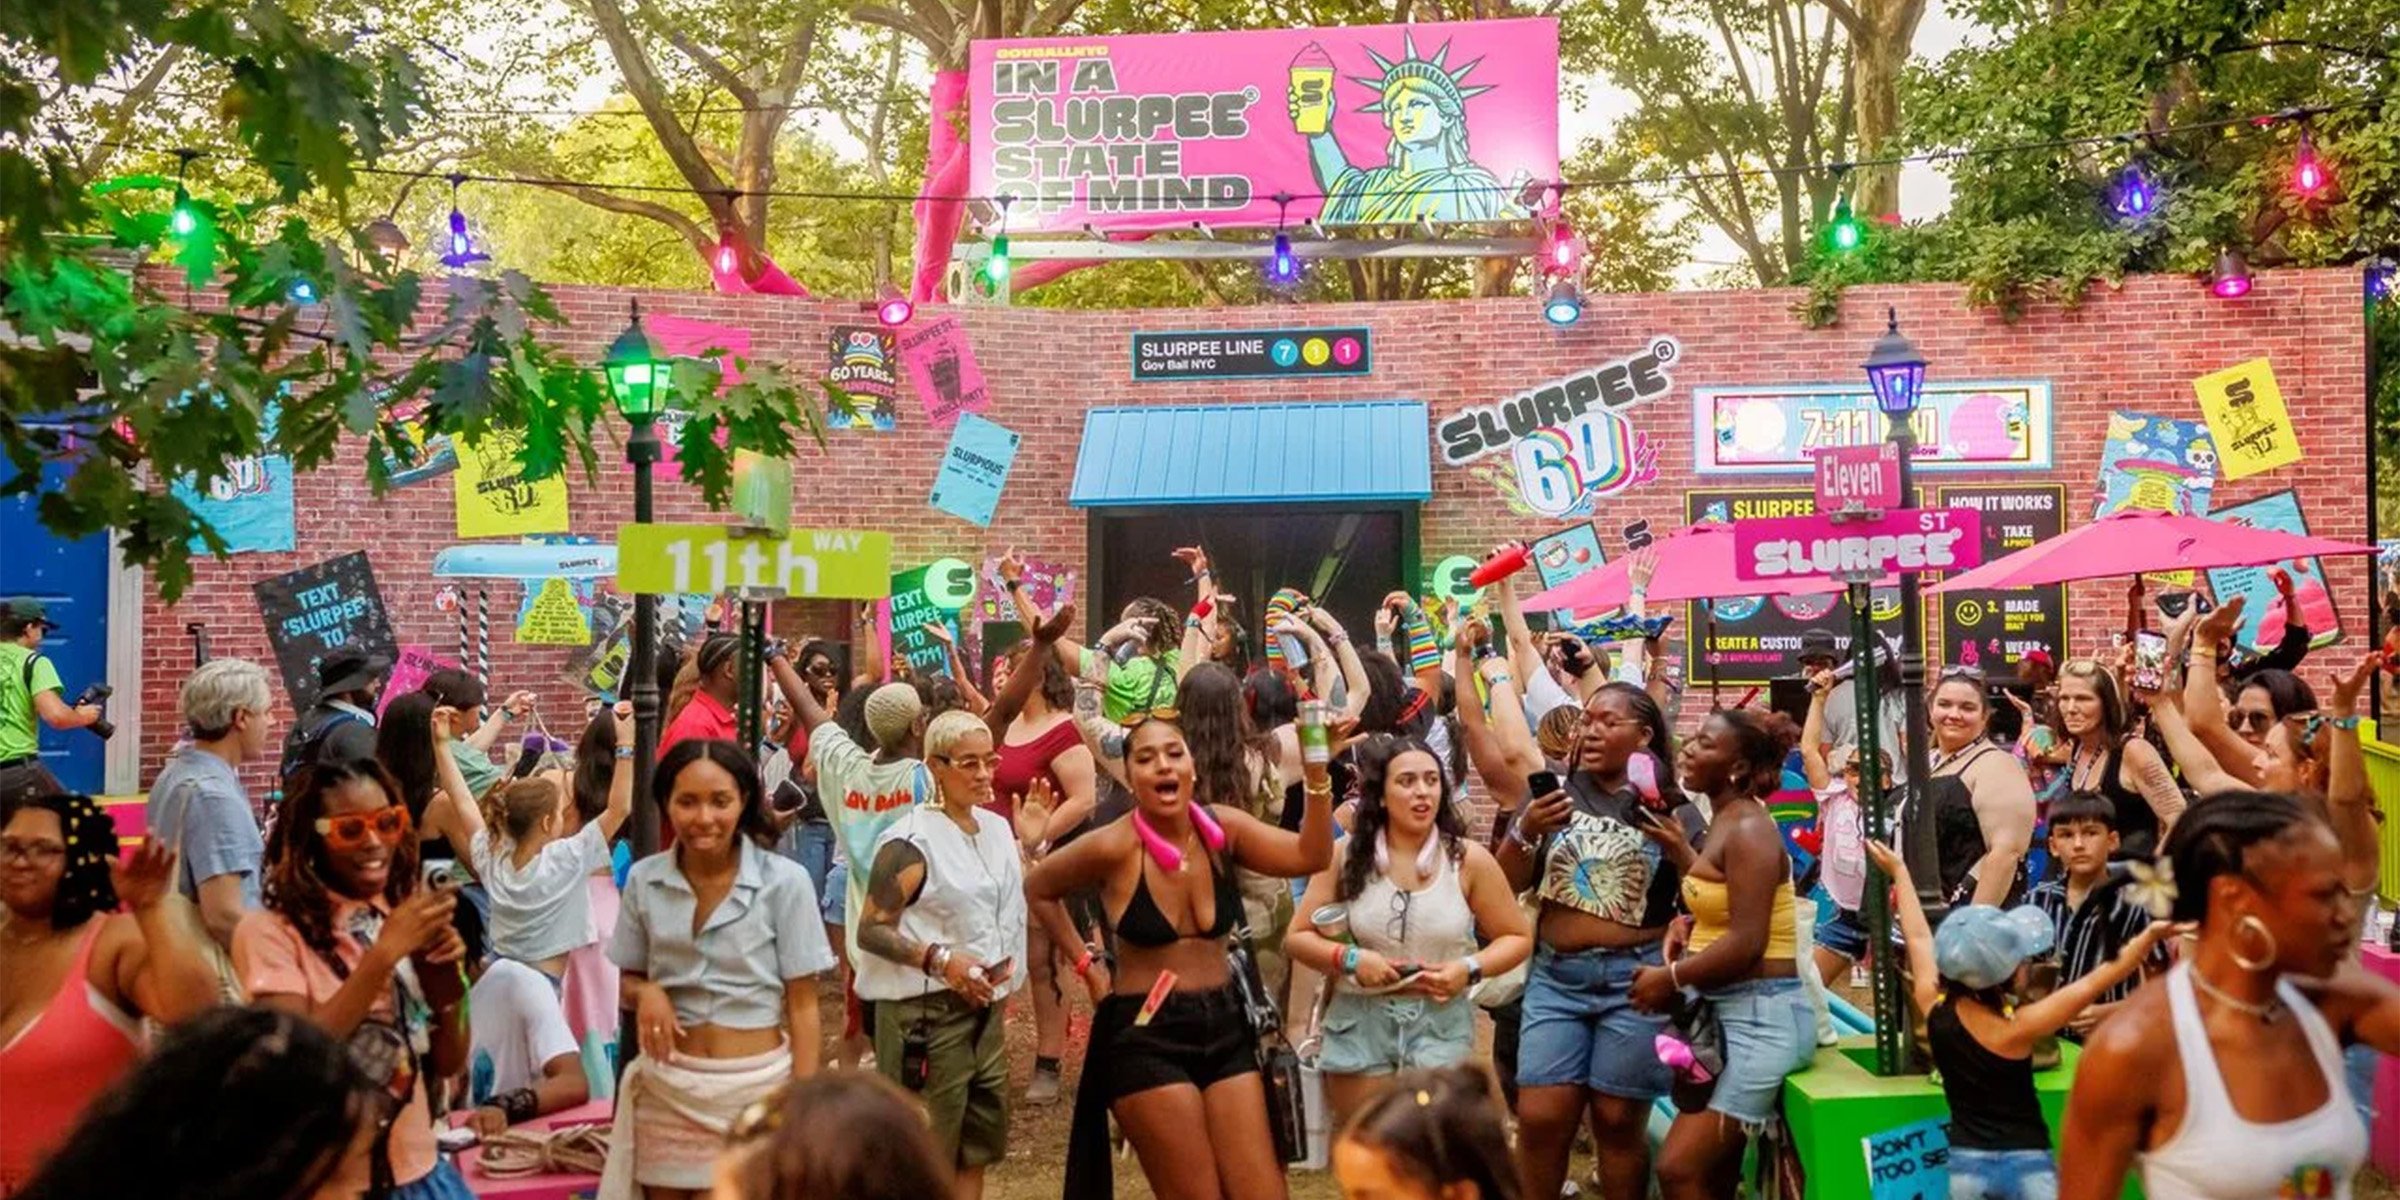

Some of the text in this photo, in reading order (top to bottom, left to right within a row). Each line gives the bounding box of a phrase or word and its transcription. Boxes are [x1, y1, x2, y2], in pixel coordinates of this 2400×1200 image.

[993, 58, 1119, 95] IN A
[993, 141, 1182, 180] STATE
[994, 176, 1252, 214] OF MIND
[1141, 341, 1222, 357] SLURPEE
[1225, 339, 1264, 355] LINE
[1279, 344, 1292, 362] 7
[830, 365, 851, 382] 60
[851, 365, 890, 382] YEARS
[1141, 358, 1216, 372] Gov Ball NYC
[1801, 409, 1871, 448] 7:11
[2231, 423, 2277, 451] SLURPEE
[1516, 411, 1633, 514] 60
[1879, 448, 1897, 461] AVE
[1823, 455, 1883, 497] Eleven
[1734, 499, 1814, 518] SLURPEE
[1950, 494, 2053, 511] HOW IT WORKS
[1919, 512, 1949, 531] ST
[2002, 525, 2034, 538] TAKE
[811, 532, 863, 551] WAY
[665, 540, 818, 595] 11th
[295, 582, 340, 610] TEXT
[891, 589, 922, 613] TEXT
[2005, 600, 2040, 613] MADE
[320, 630, 345, 649] TO
[906, 630, 925, 649] TO
[1750, 636, 1758, 650] A
[1760, 636, 1802, 650] CUSTO
[2005, 641, 2041, 653] WEAR
[1873, 1158, 1917, 1183] TOO
